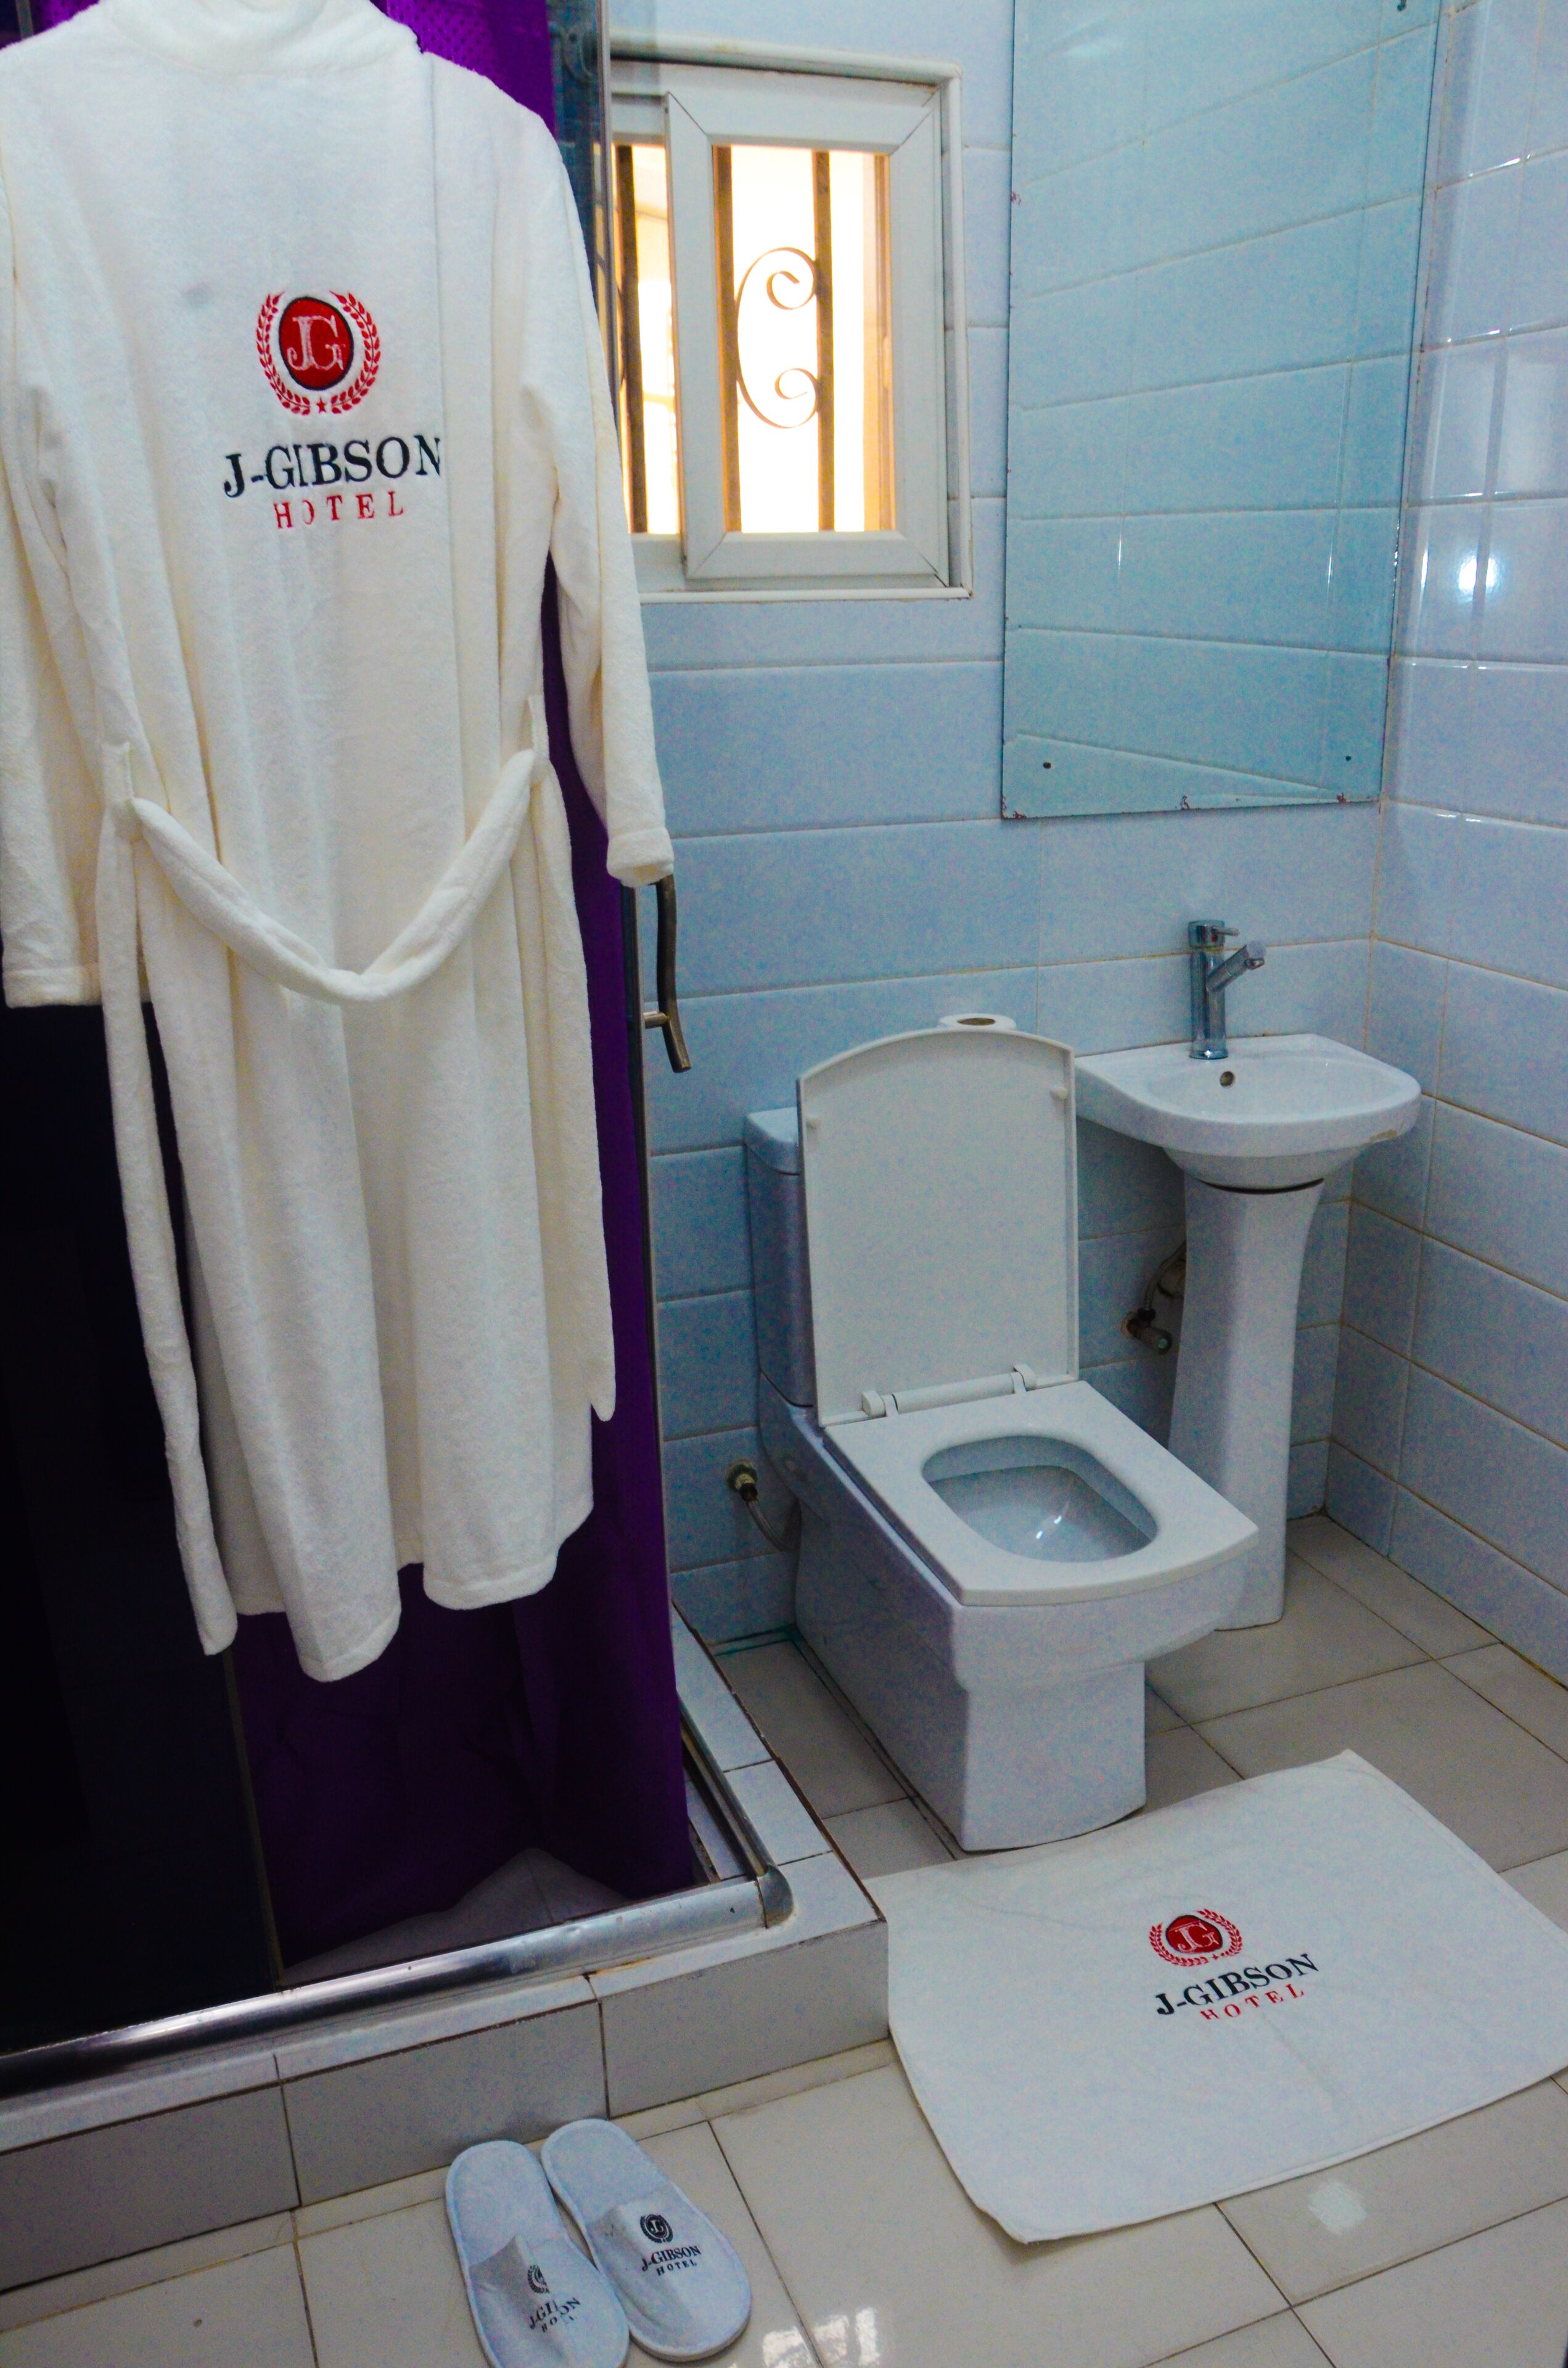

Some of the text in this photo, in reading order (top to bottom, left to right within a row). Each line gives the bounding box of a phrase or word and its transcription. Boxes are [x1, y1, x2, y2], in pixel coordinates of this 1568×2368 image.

[286, 314, 346, 371] JG
[223, 434, 441, 498] J-GIBSON
[273, 491, 404, 529] HOTEL
[1174, 1920, 1220, 1954] JG
[1155, 1953, 1319, 2015] J-GIBSON
[1200, 1983, 1305, 2021] HOTEL
[641, 2245, 702, 2272] J-GIBSON
[656, 2259, 697, 2276] HOTEL
[530, 2297, 581, 2330] J-GION
